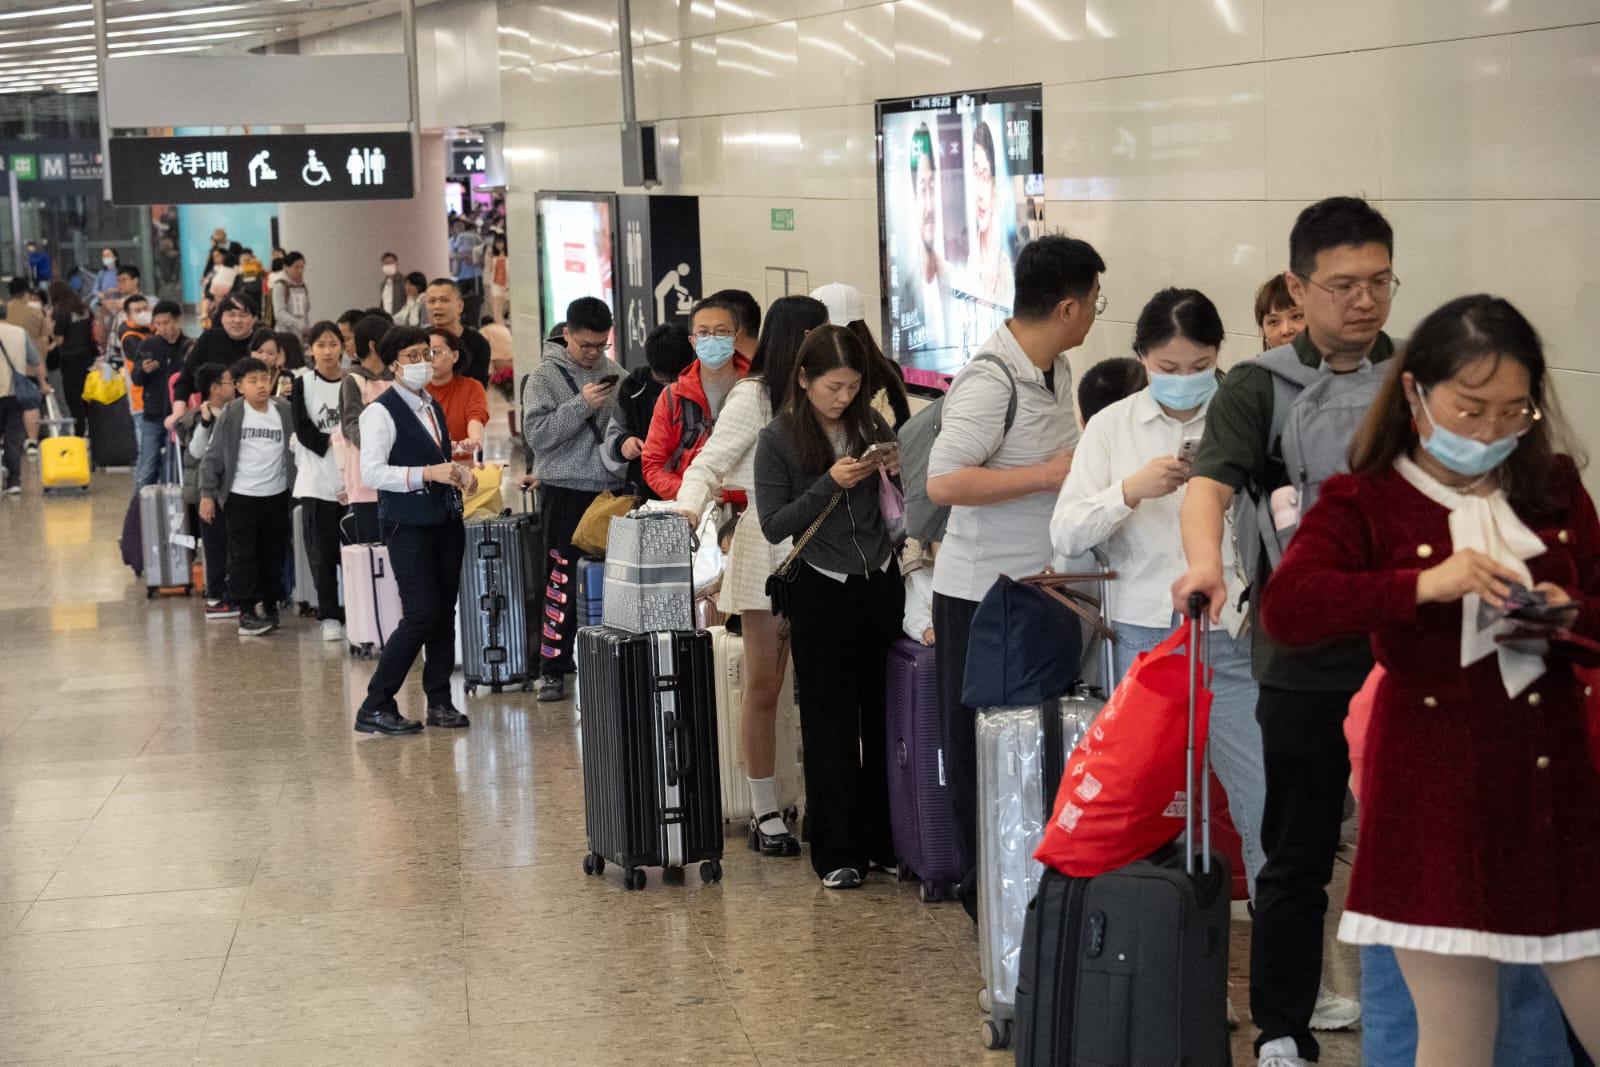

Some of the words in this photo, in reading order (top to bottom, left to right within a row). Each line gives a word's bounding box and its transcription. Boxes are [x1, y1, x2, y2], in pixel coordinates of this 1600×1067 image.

[44, 158, 62, 176] M
[159, 151, 228, 175] 洗手間
[192, 177, 230, 189] Toilets
